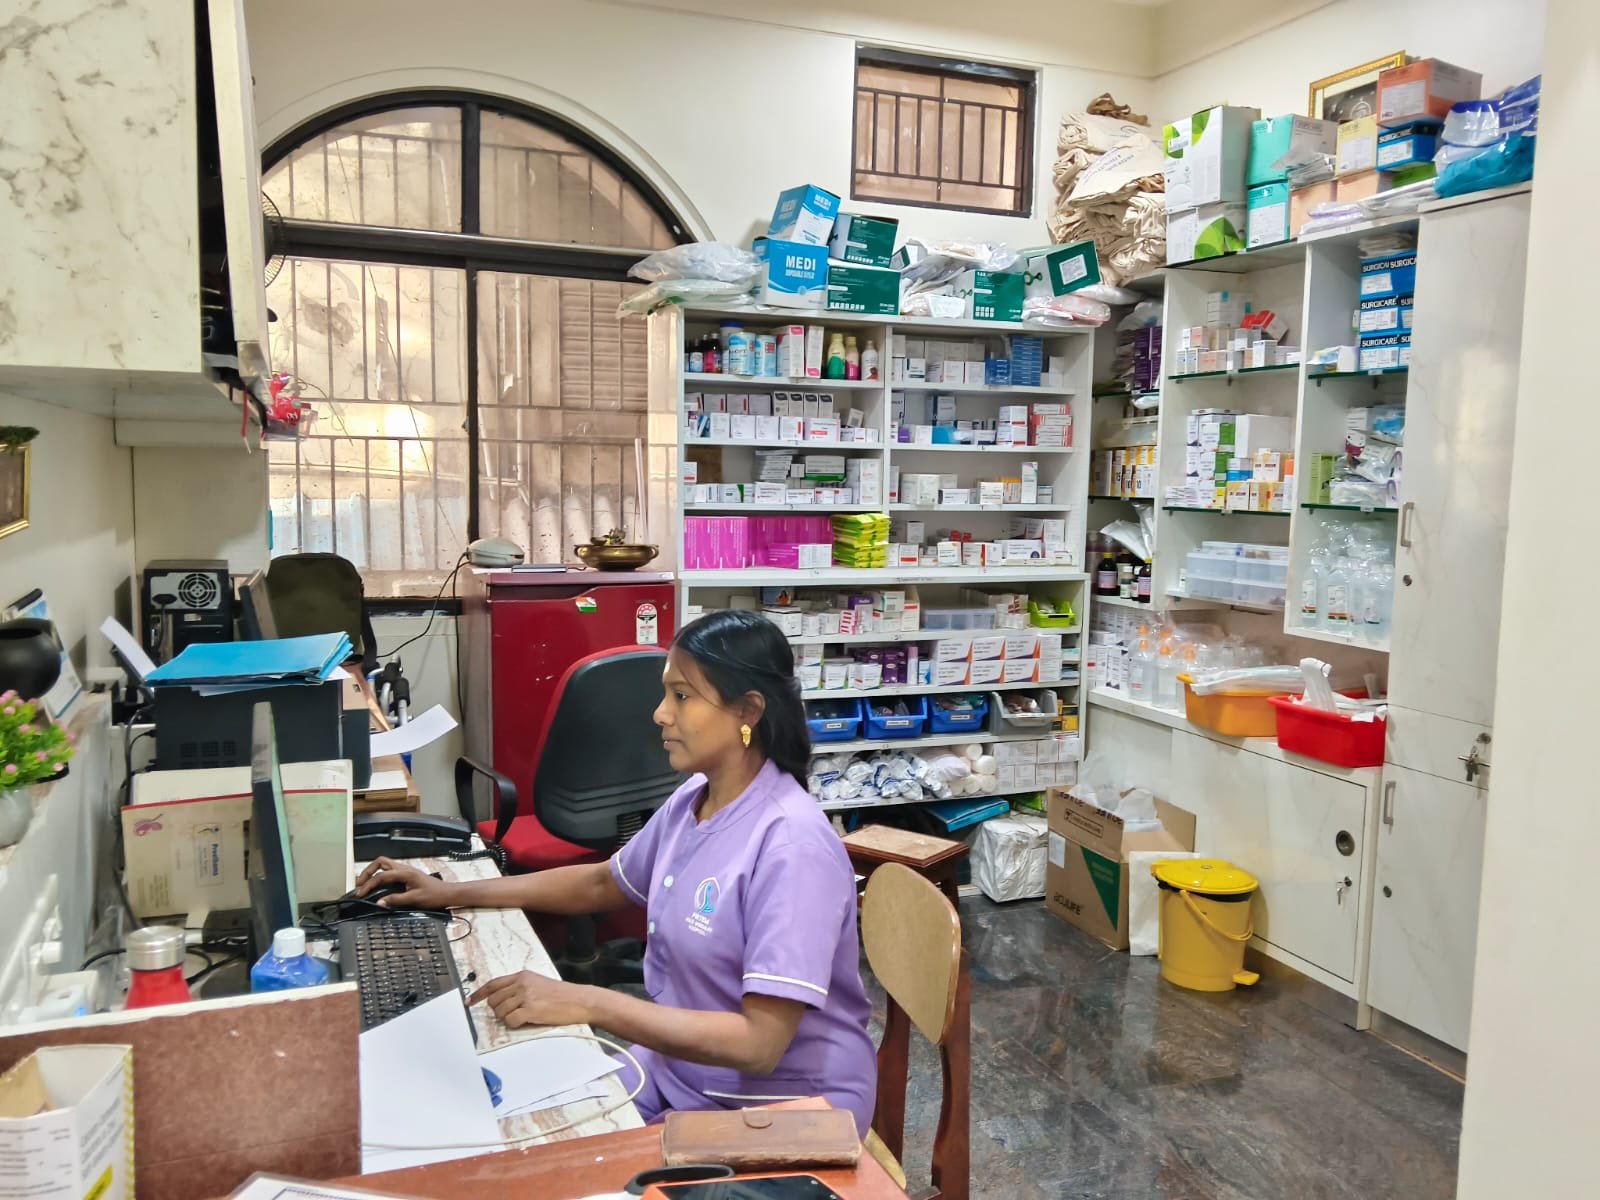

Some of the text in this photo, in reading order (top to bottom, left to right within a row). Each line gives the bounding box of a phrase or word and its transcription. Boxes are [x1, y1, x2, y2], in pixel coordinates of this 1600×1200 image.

[786, 255, 816, 271] MEDI
[1361, 298, 1397, 309] SURGICARE
[1361, 337, 1398, 347] SURGICARE
